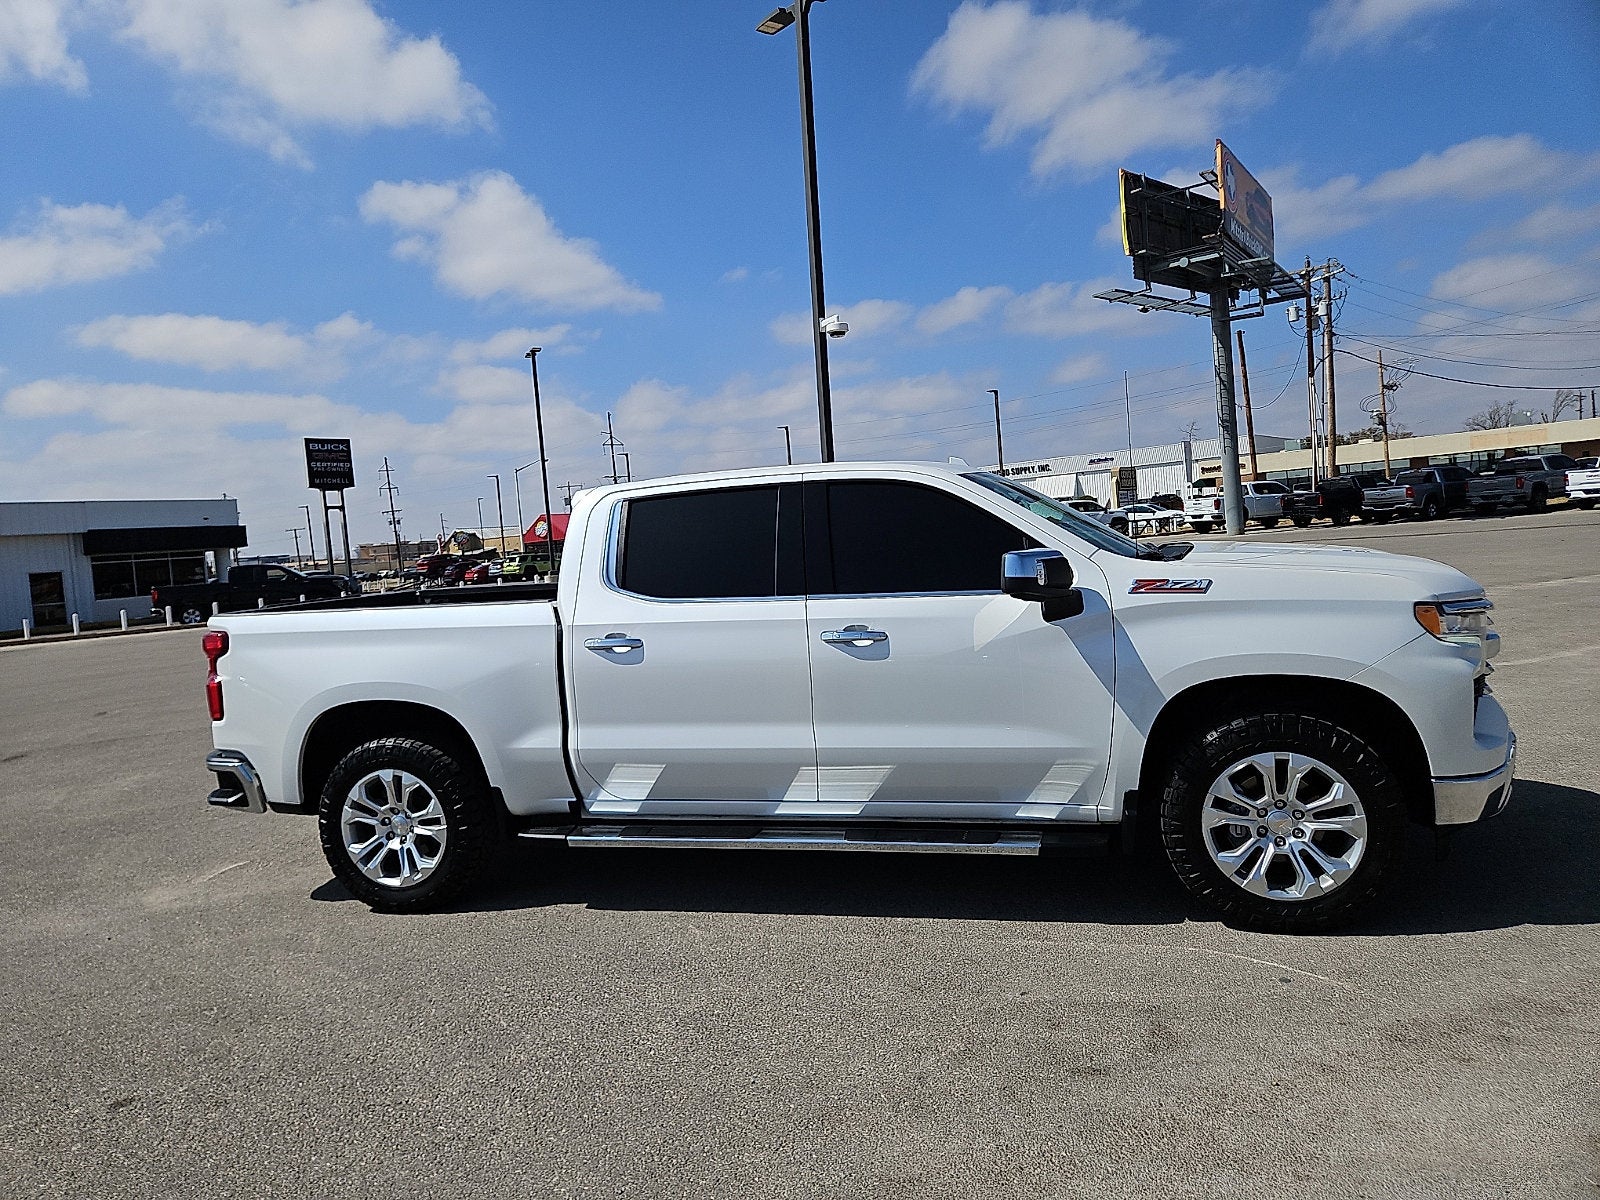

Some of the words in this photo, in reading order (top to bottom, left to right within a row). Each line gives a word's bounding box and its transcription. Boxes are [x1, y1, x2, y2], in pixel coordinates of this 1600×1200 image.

[309, 443, 348, 451] BUICK
[1010, 465, 1038, 476] SUPPLY,
[1037, 463, 1053, 473] INC.
[1128, 578, 1213, 594] Z71
